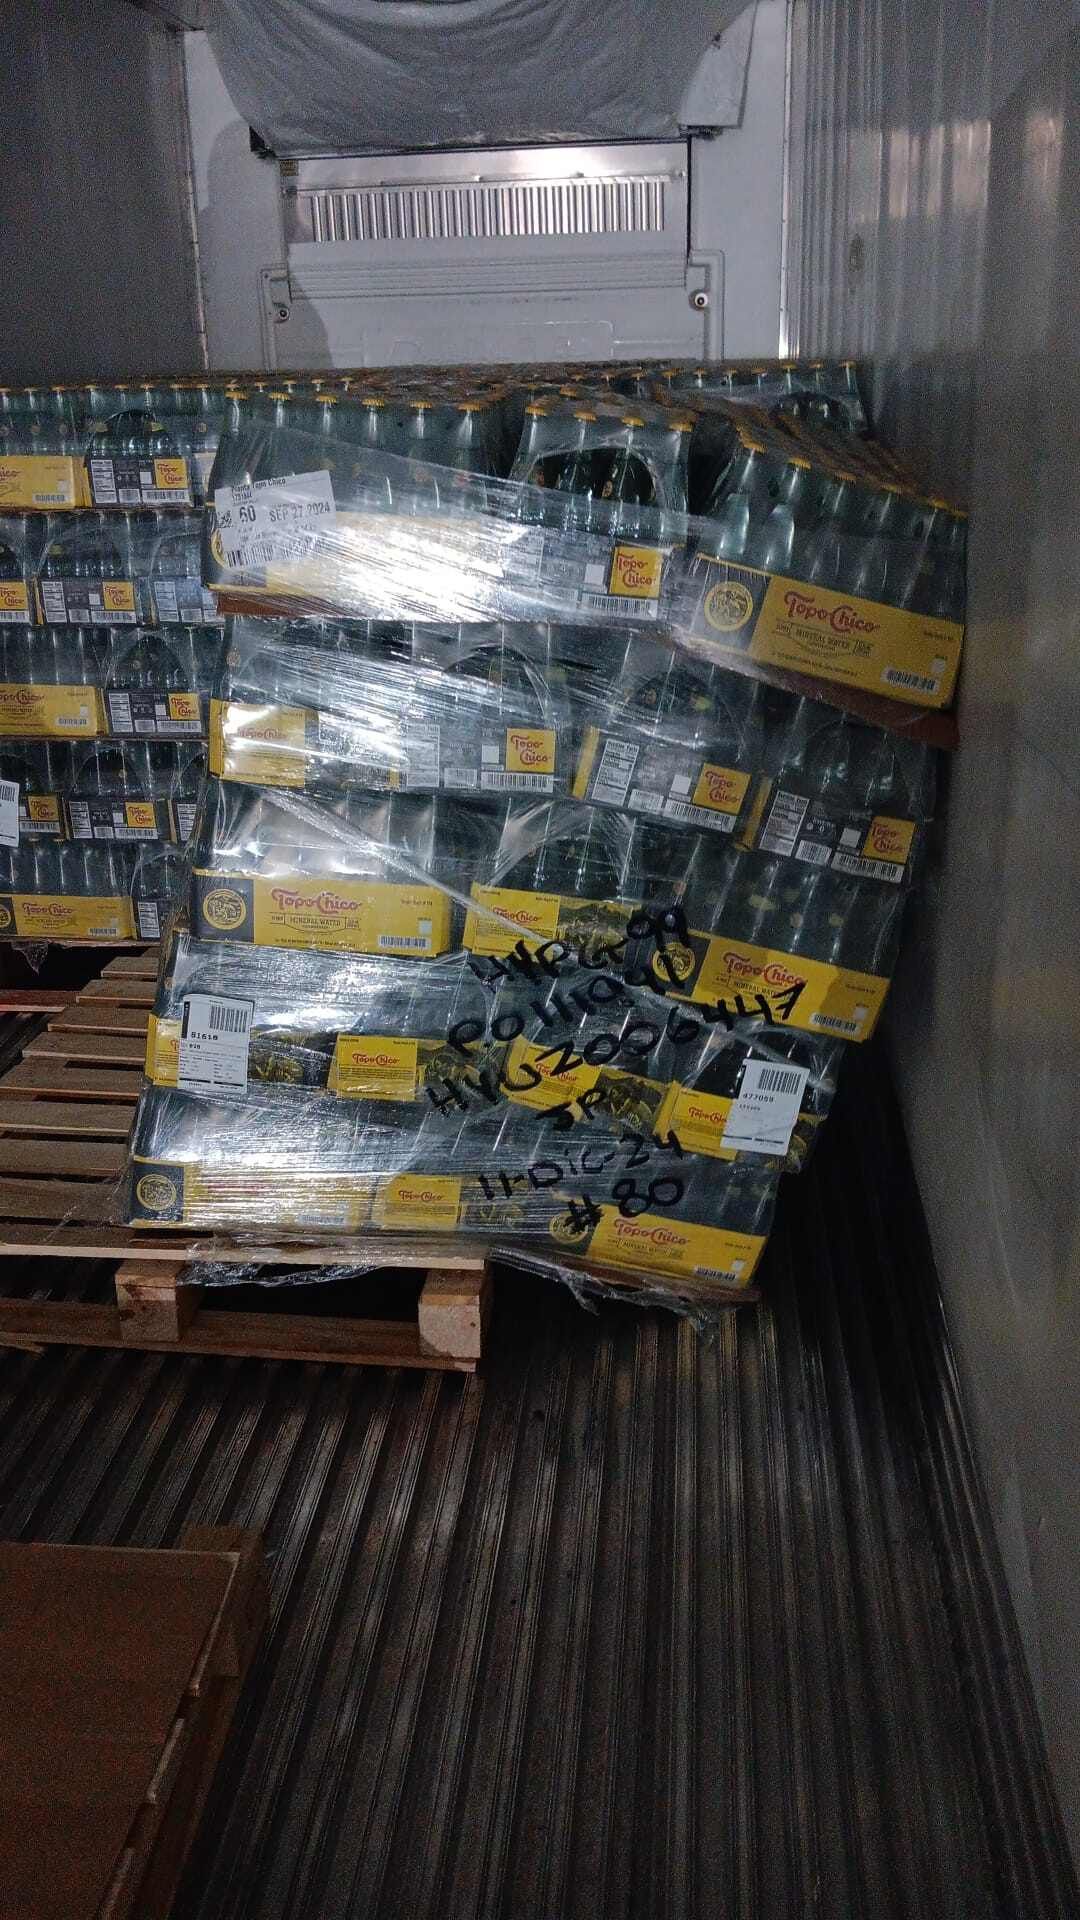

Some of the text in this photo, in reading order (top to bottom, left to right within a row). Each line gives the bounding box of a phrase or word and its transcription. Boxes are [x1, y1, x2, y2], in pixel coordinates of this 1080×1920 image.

[239, 504, 257, 523] 60
[617, 552, 648, 573] Topo
[622, 569, 657, 588] Chico
[784, 590, 876, 633] Topo Chico
[511, 734, 543, 750] Topo
[520, 749, 551, 766] Chico
[704, 770, 737, 789] Topo
[871, 822, 898, 839] Topo
[271, 887, 359, 915] Topo Chico
[514, 910, 541, 926] Chico
[722, 951, 806, 987] Topo Chico
[352, 1052, 400, 1066] Topo Chico
[688, 1105, 709, 1121] Topo
[614, 1218, 688, 1245] Topo Chico
